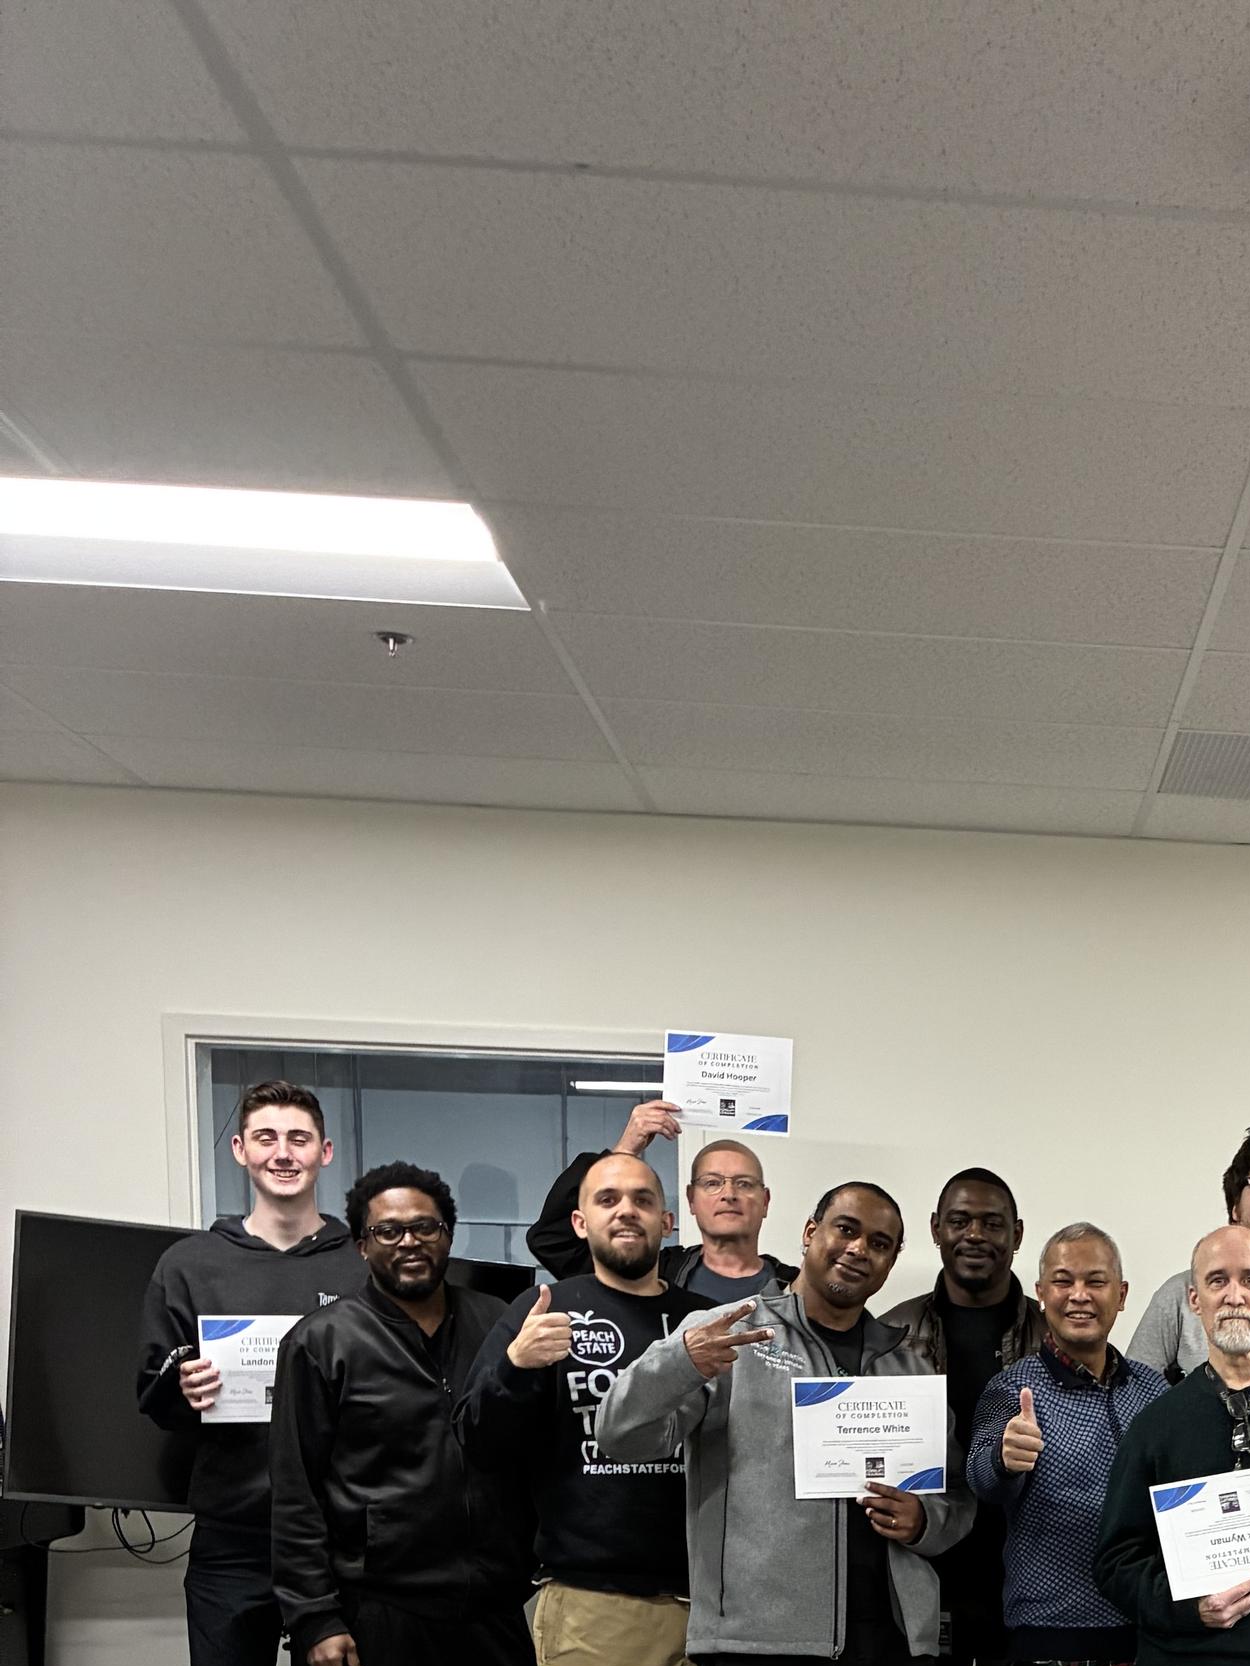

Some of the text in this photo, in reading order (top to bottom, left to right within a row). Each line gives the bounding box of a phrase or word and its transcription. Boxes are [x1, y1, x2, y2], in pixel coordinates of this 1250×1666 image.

[700, 1052, 757, 1063] CERTIFICATE
[711, 1061, 759, 1069] COMPLETION
[701, 1071, 757, 1082] David Hooper
[572, 1330, 615, 1342] PEACH
[578, 1342, 616, 1354] STATE
[241, 1358, 274, 1366] Landon
[566, 1368, 626, 1401] FO
[838, 1401, 906, 1412] CERTIFICATE
[837, 1424, 910, 1434] Terrence White
[1210, 1533, 1246, 1546] Wyman
